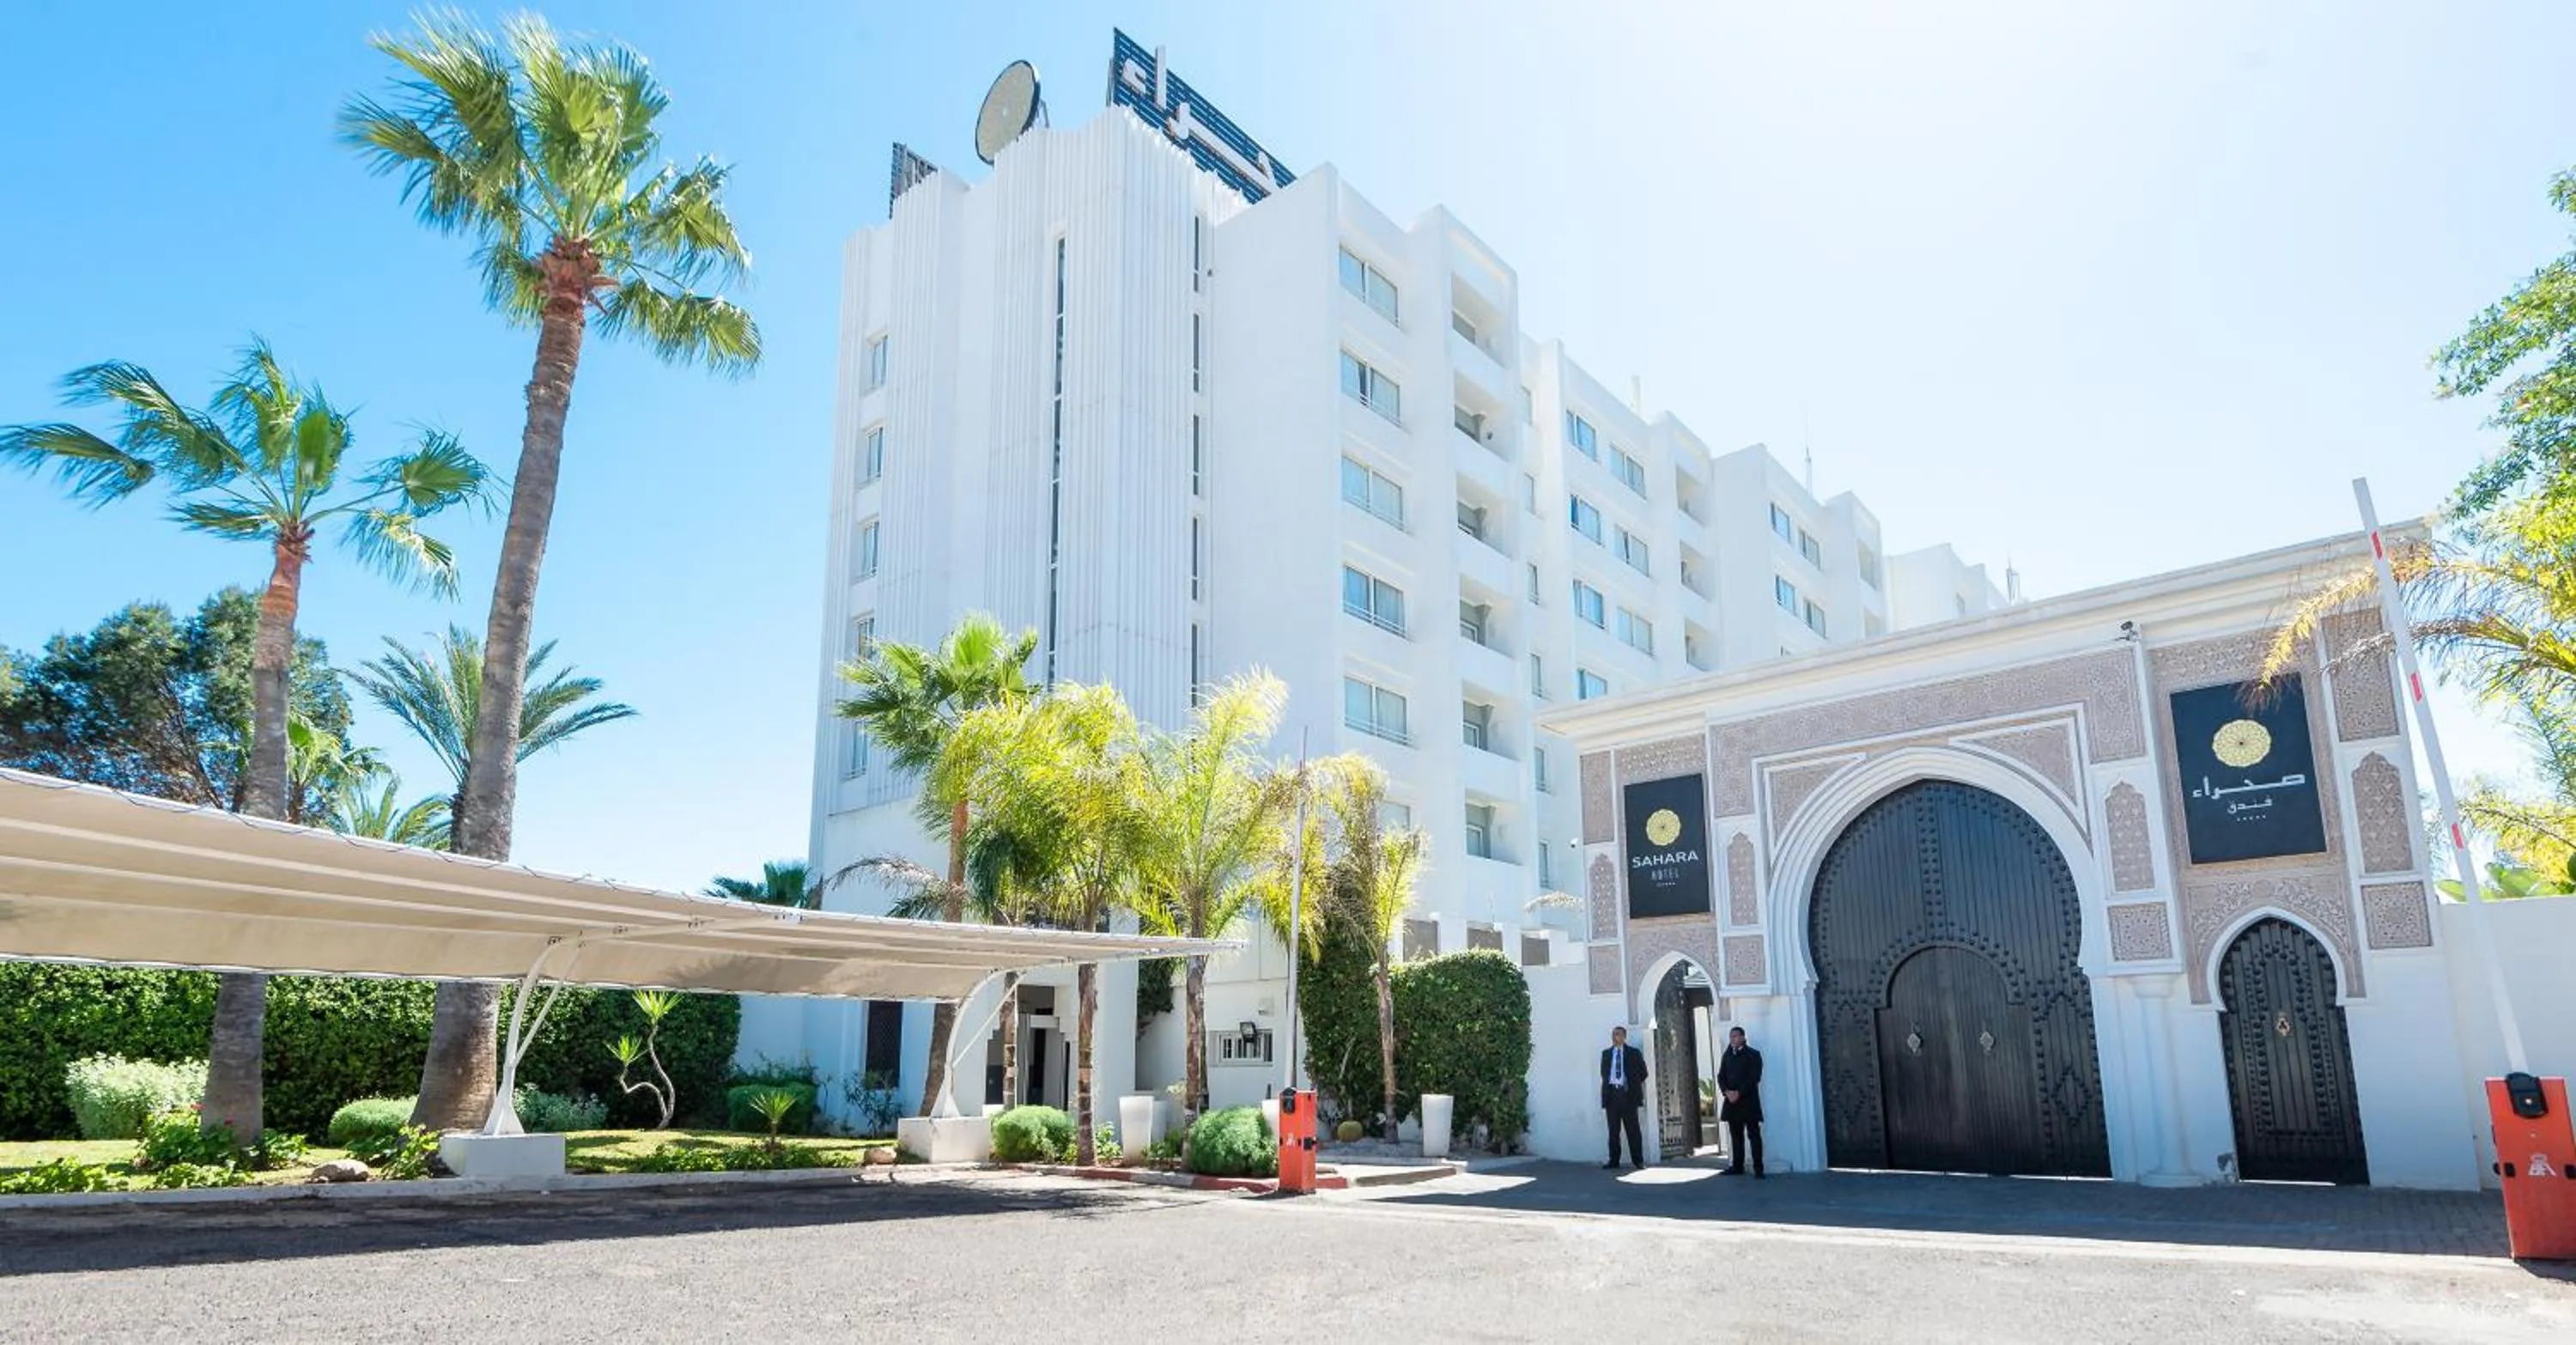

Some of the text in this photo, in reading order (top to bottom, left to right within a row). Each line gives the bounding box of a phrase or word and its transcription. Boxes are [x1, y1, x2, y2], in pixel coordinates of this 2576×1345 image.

[2192, 774, 2306, 800] صحراء
[2227, 794, 2273, 814] فندق
[1632, 849, 1698, 868] SAHARA
